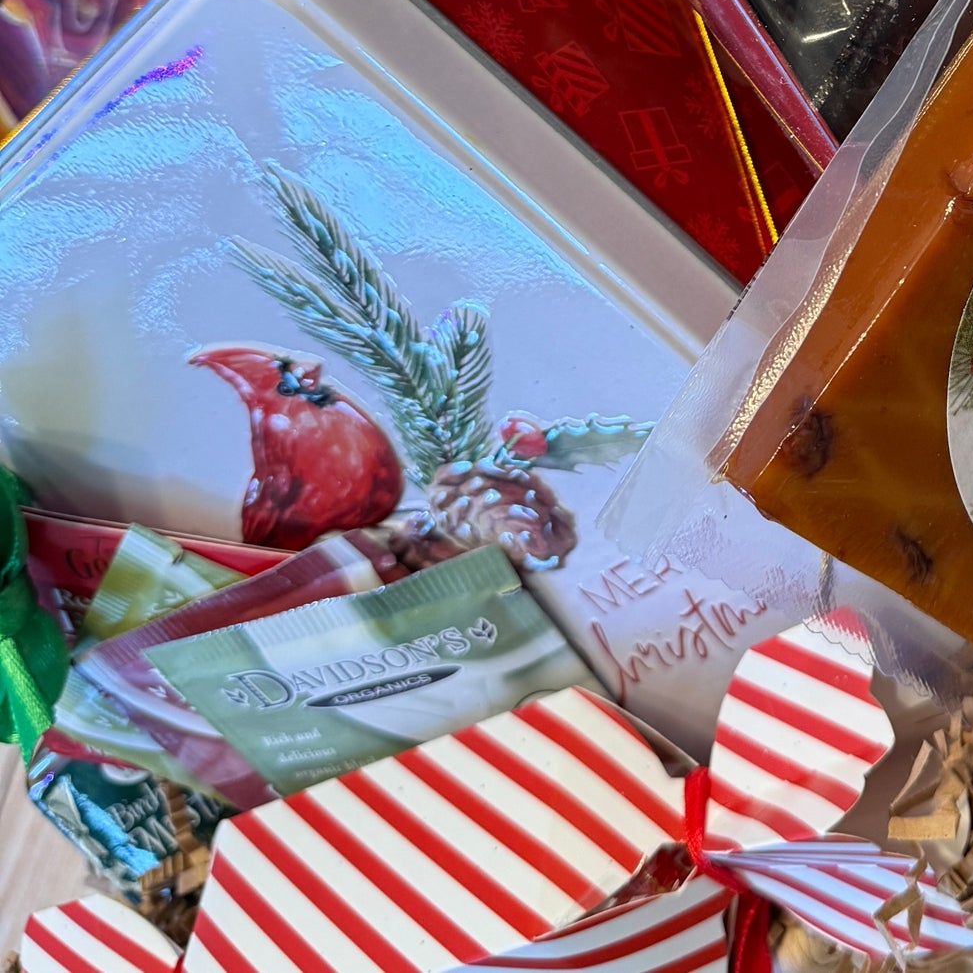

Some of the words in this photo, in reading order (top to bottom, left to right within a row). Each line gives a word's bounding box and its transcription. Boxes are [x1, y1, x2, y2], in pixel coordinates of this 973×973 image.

[333, 672, 432, 705] ORGANICS
[260, 732, 294, 747] Rich
[294, 726, 322, 741] and
[277, 746, 338, 763] delicious
